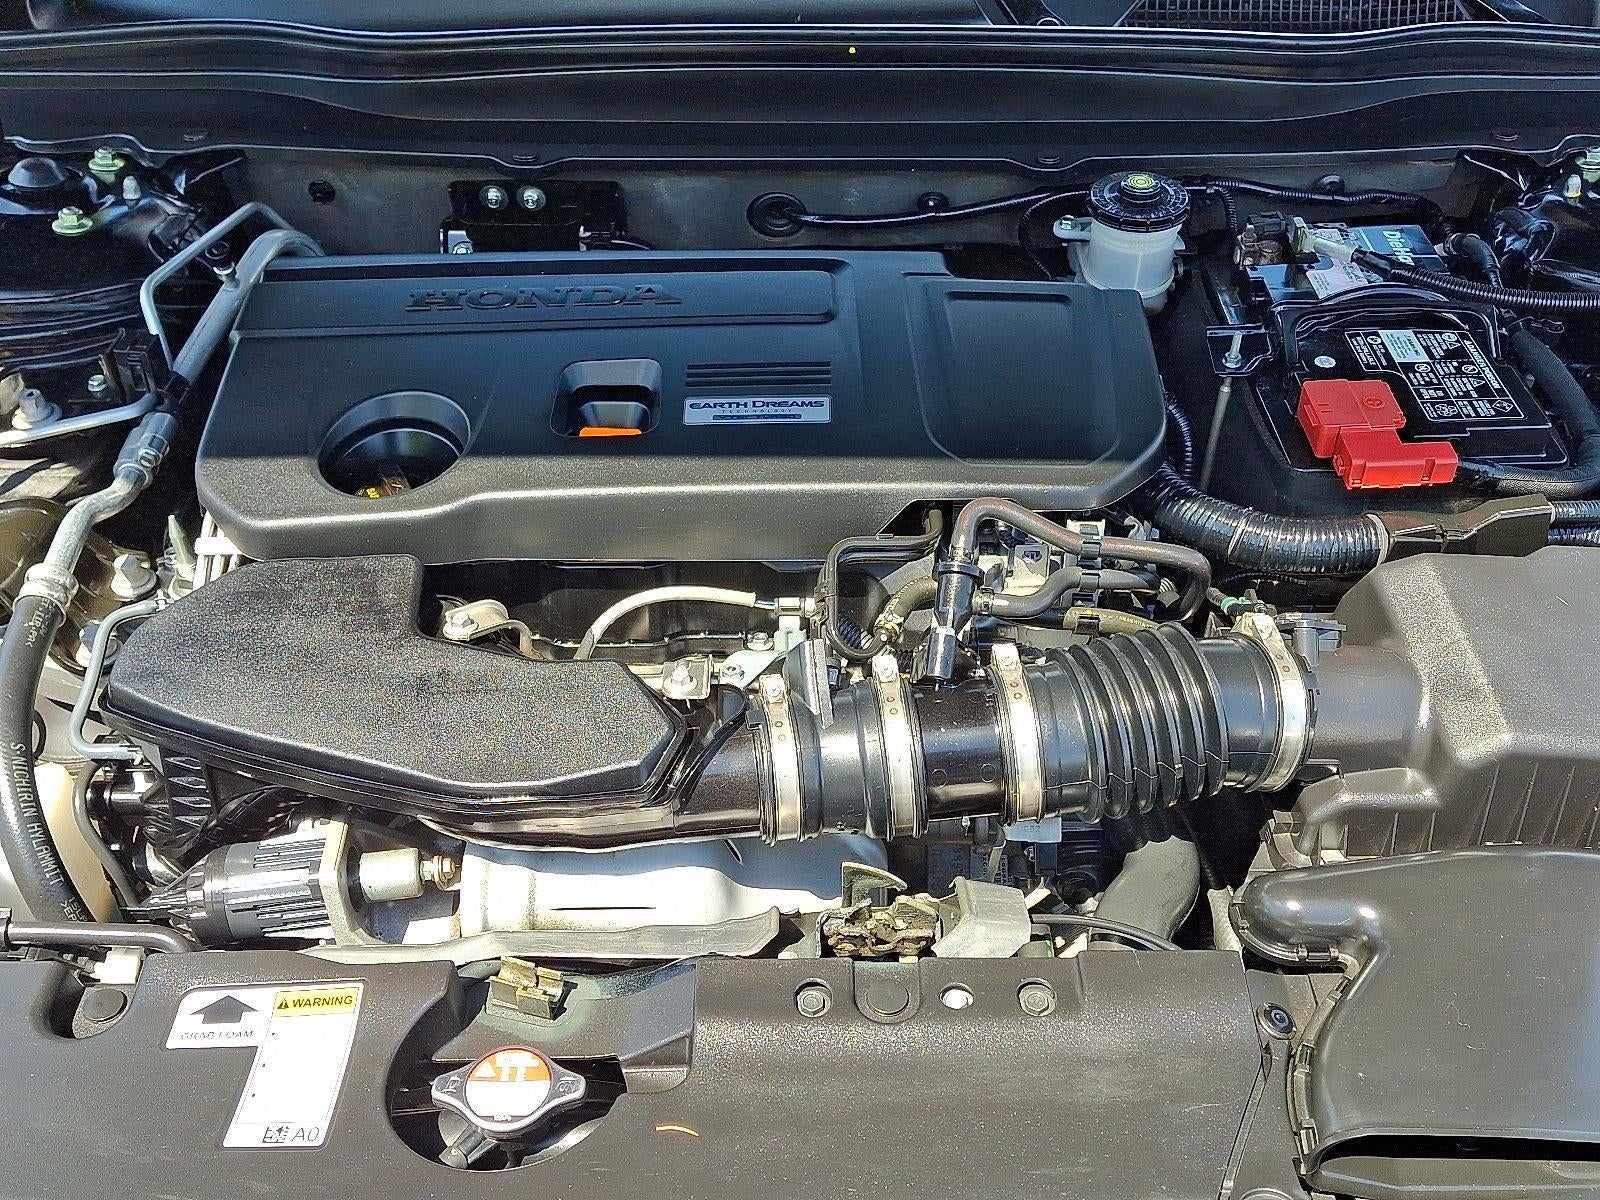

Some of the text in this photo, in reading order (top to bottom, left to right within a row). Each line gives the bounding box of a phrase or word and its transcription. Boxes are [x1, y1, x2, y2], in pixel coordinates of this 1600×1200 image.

[404, 284, 682, 312] HONDA
[689, 399, 825, 410] EARTH DREAMS
[26, 822, 64, 885] HYLAMMIT
[292, 995, 353, 1008] WARNING
